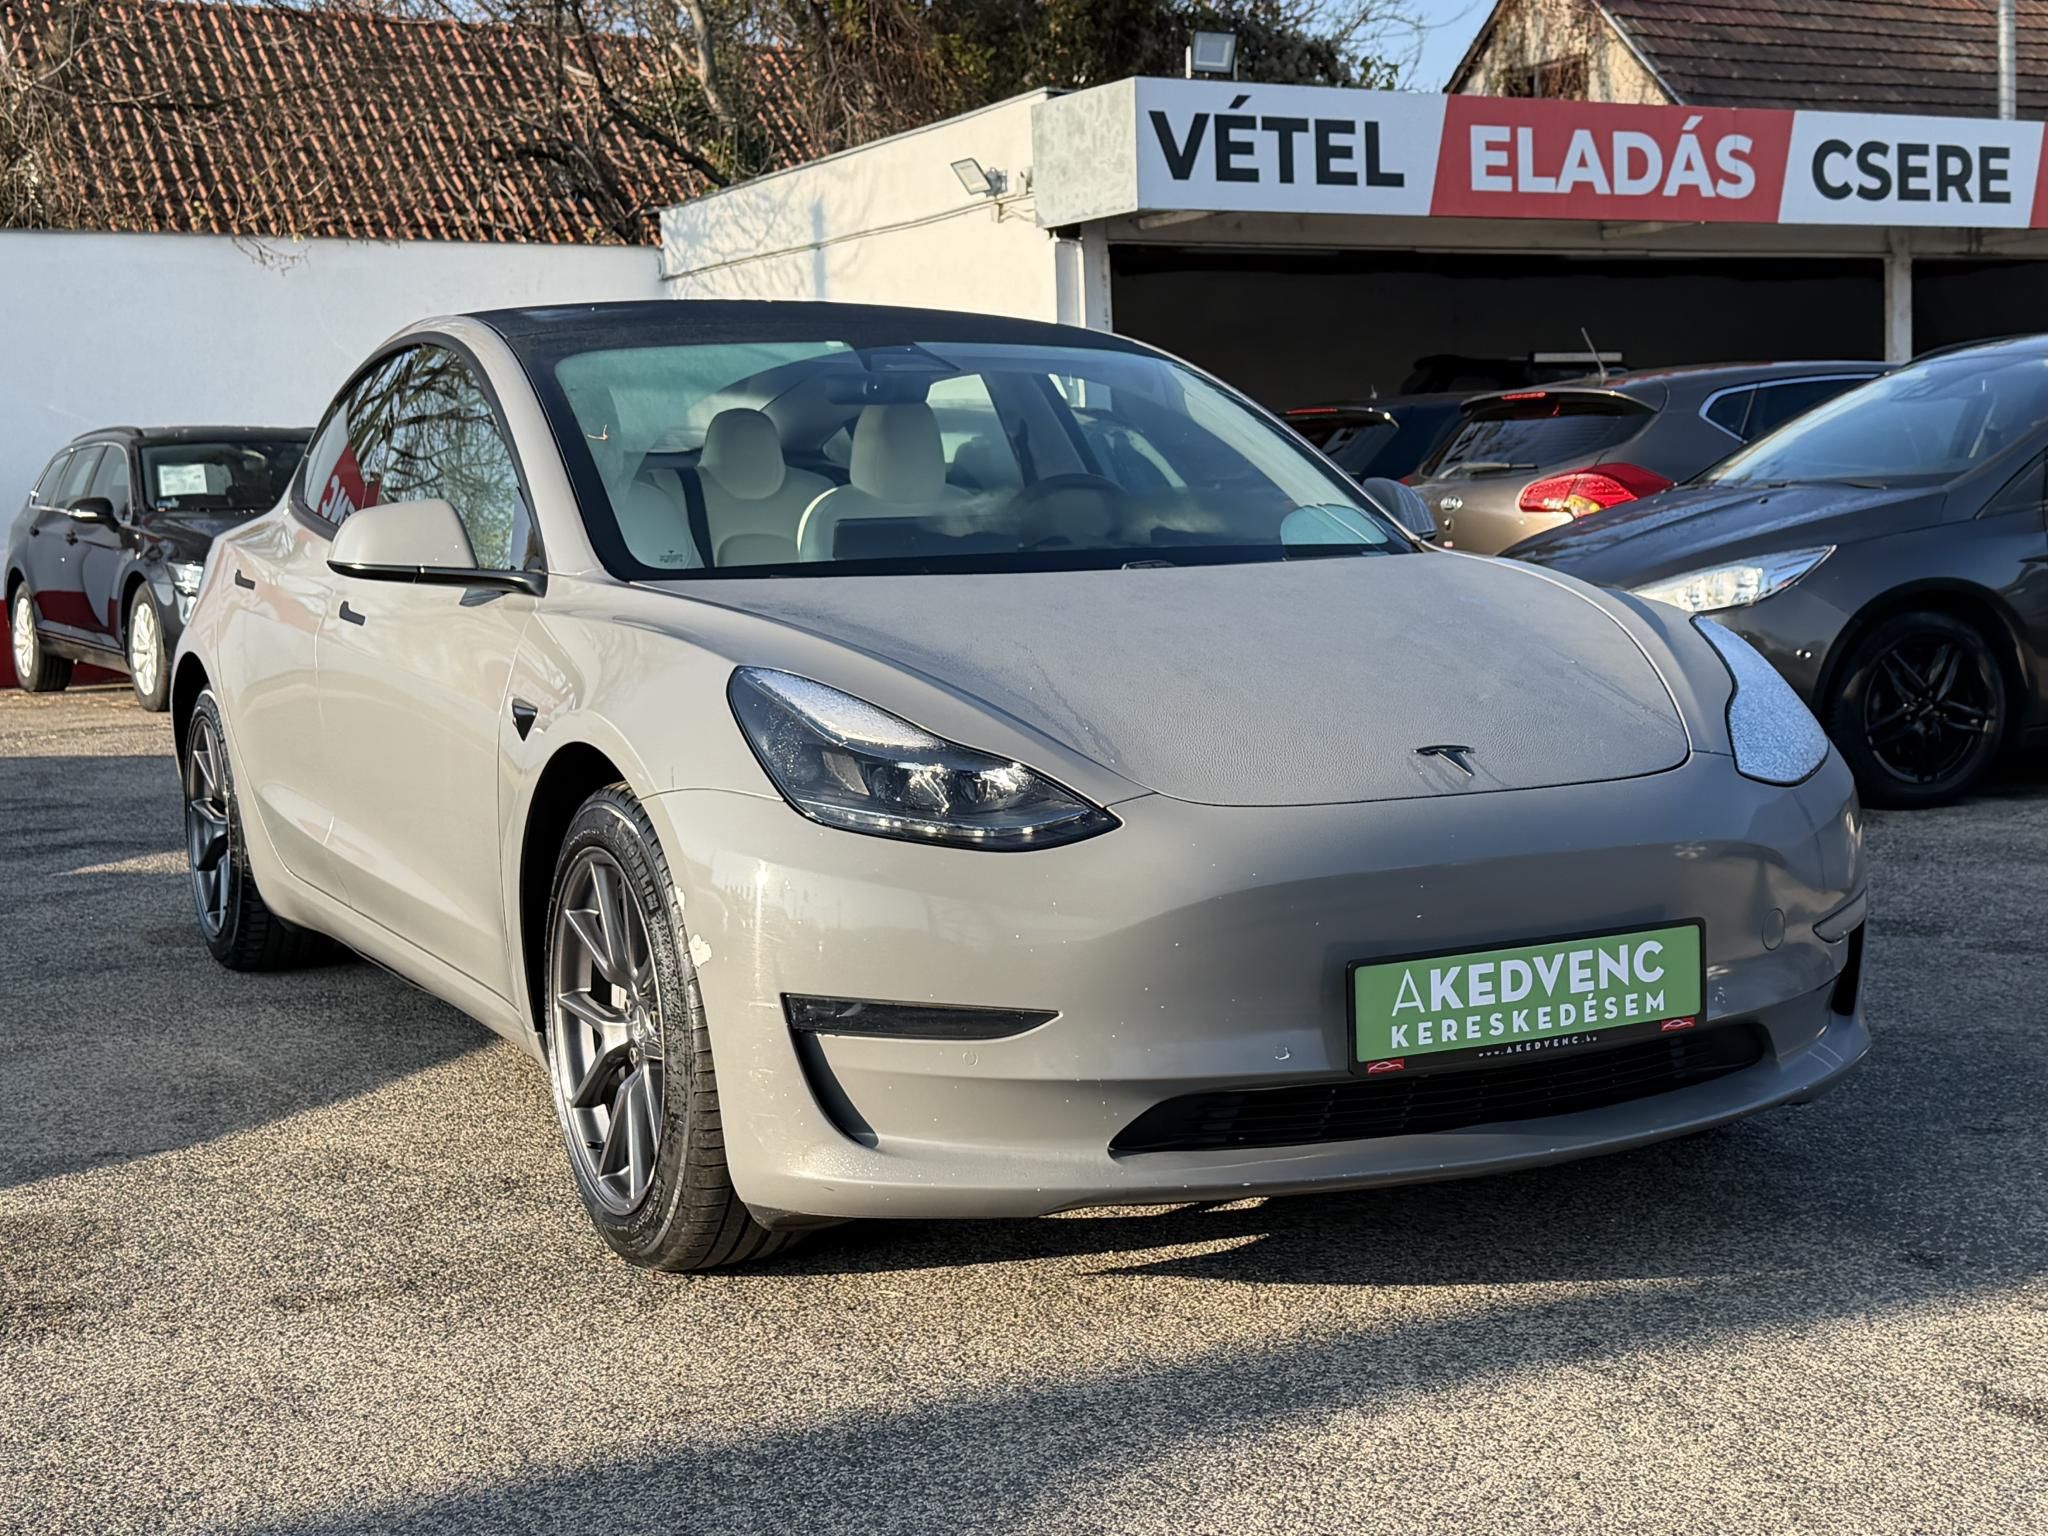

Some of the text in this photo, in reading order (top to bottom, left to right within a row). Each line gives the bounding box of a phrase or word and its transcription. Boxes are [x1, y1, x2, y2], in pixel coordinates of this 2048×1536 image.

[1148, 95, 1404, 188] VÉTEL
[1470, 115, 1756, 199] ELADÁS
[1811, 138, 2011, 204] CSERE
[1391, 989, 1665, 1049] KERESKEDÉSEM
